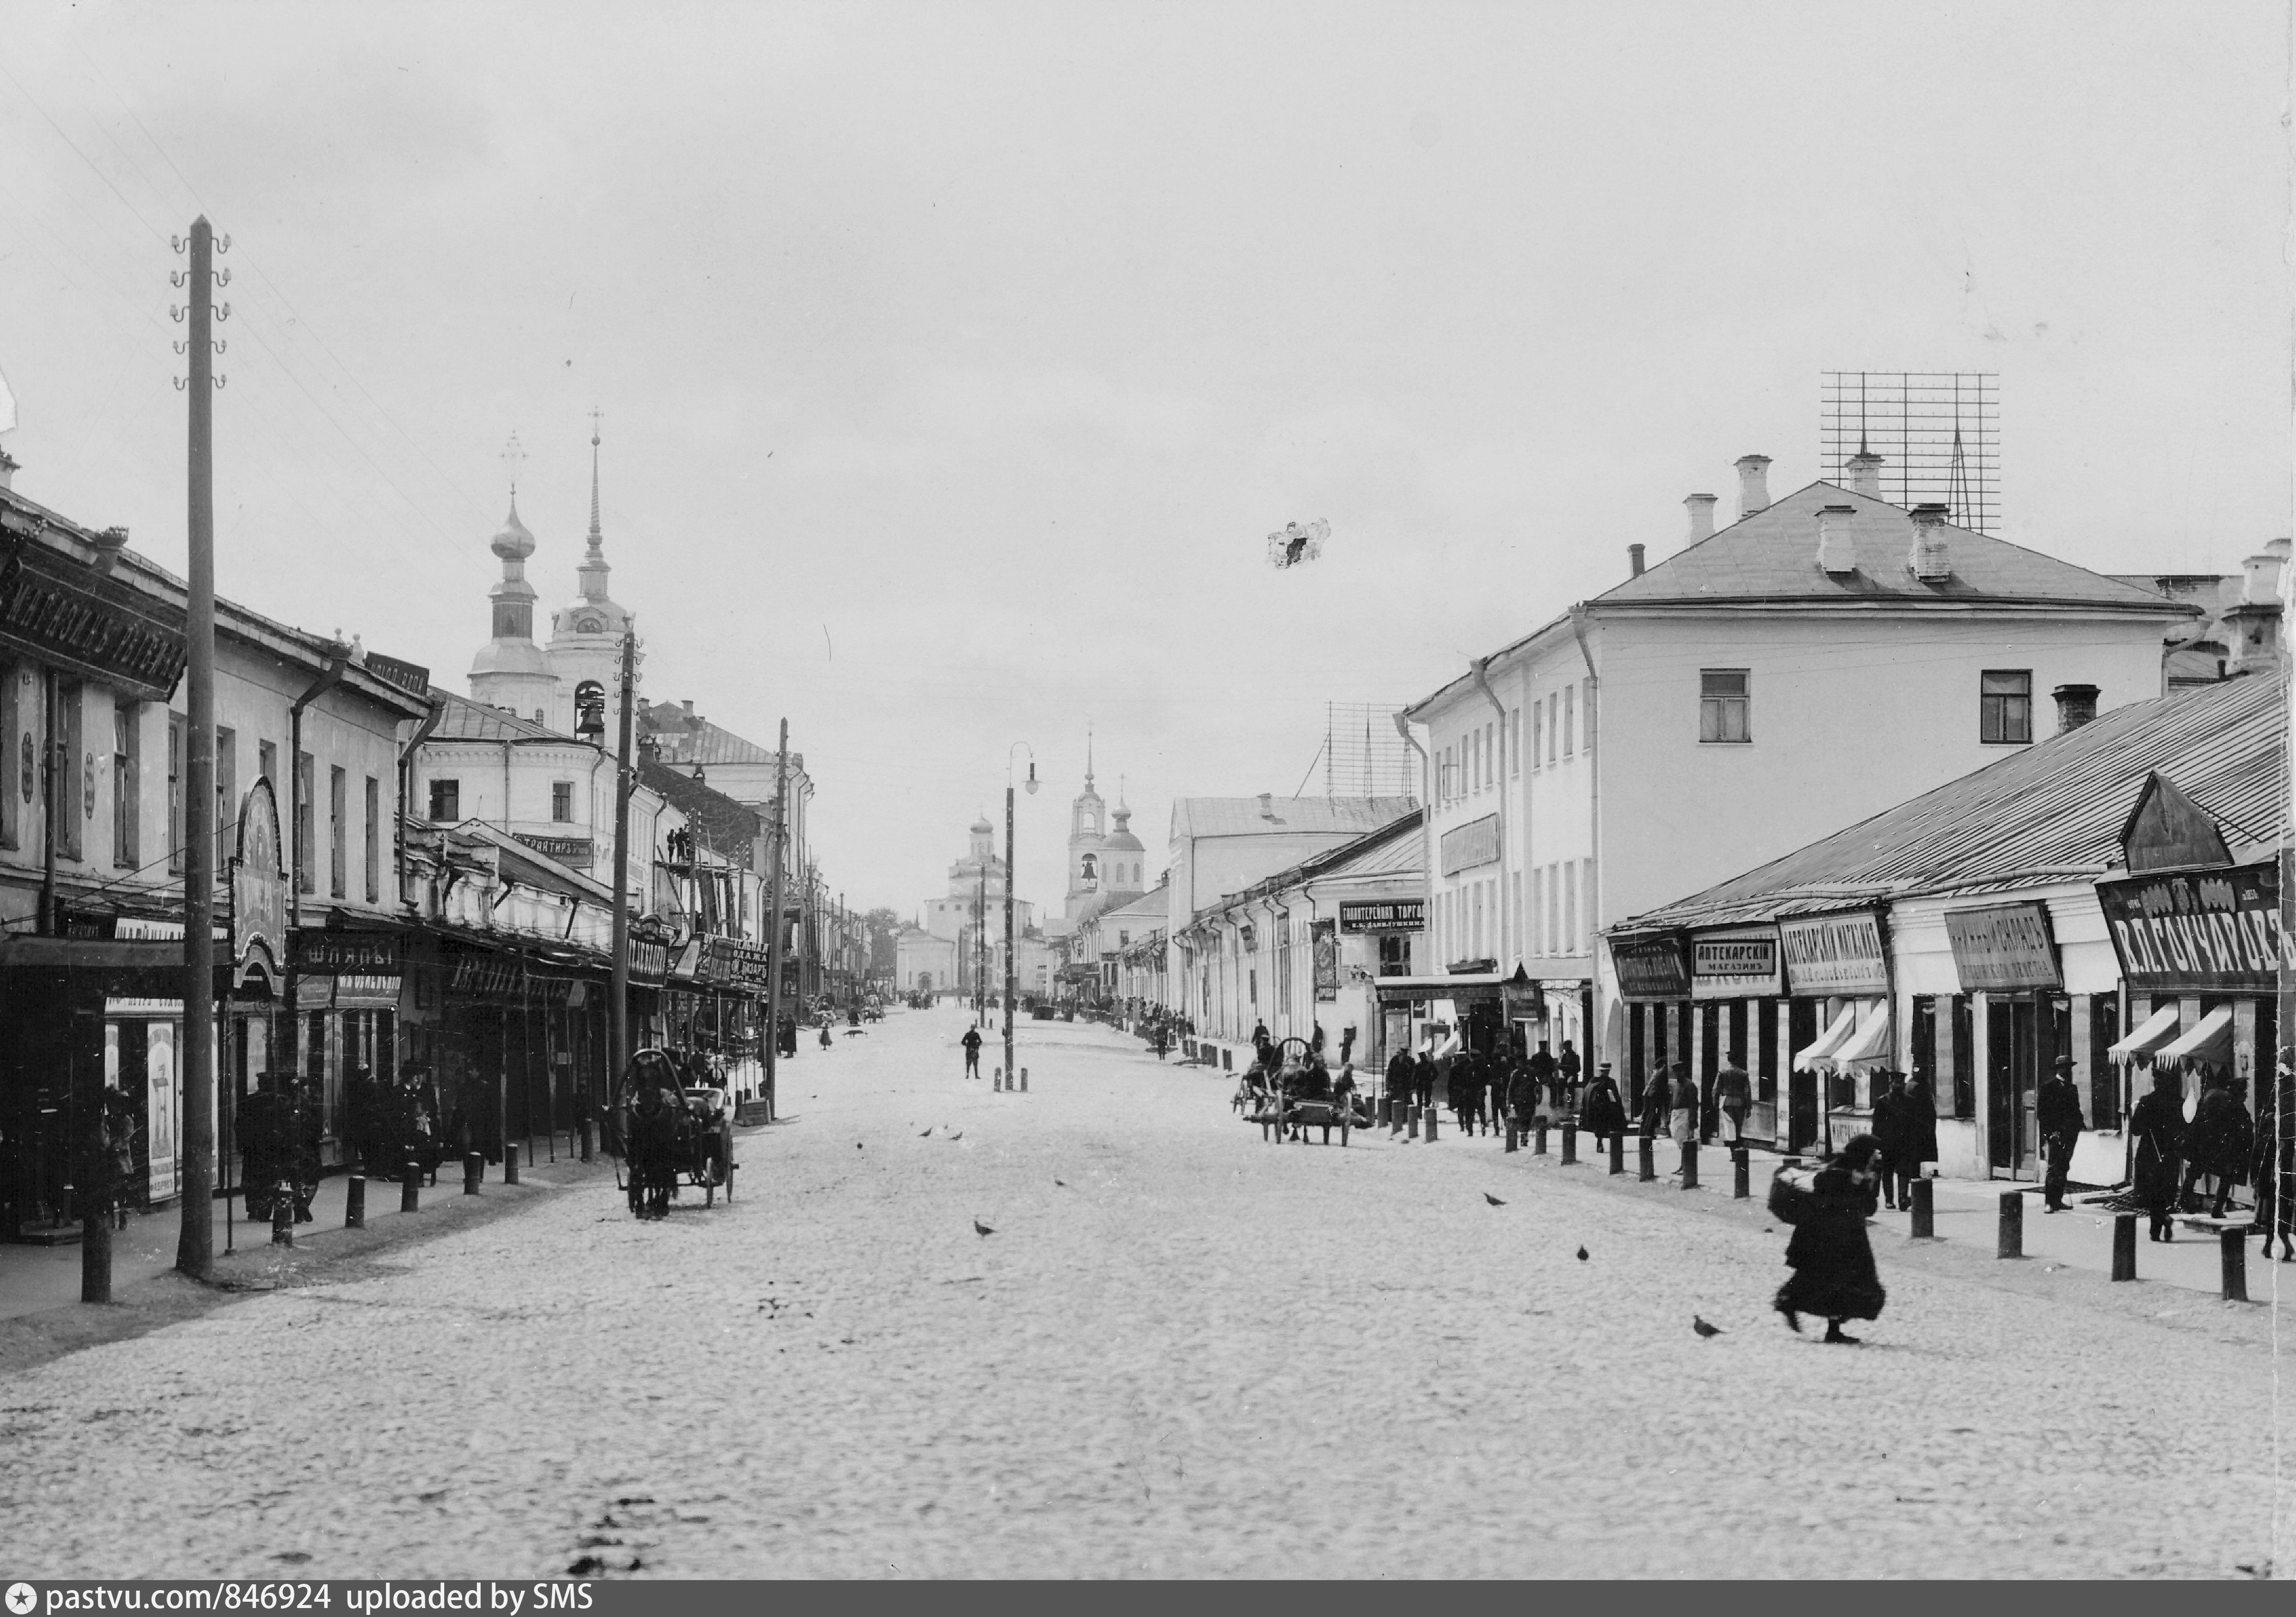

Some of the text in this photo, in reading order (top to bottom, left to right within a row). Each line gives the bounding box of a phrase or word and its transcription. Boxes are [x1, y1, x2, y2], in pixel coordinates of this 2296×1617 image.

[309, 947, 392, 965] ШЛЯПЫ
[1698, 944, 1769, 960] АПТЕКАРСКІЙ
[1708, 962, 1763, 971] МАГАЗИНЪ
